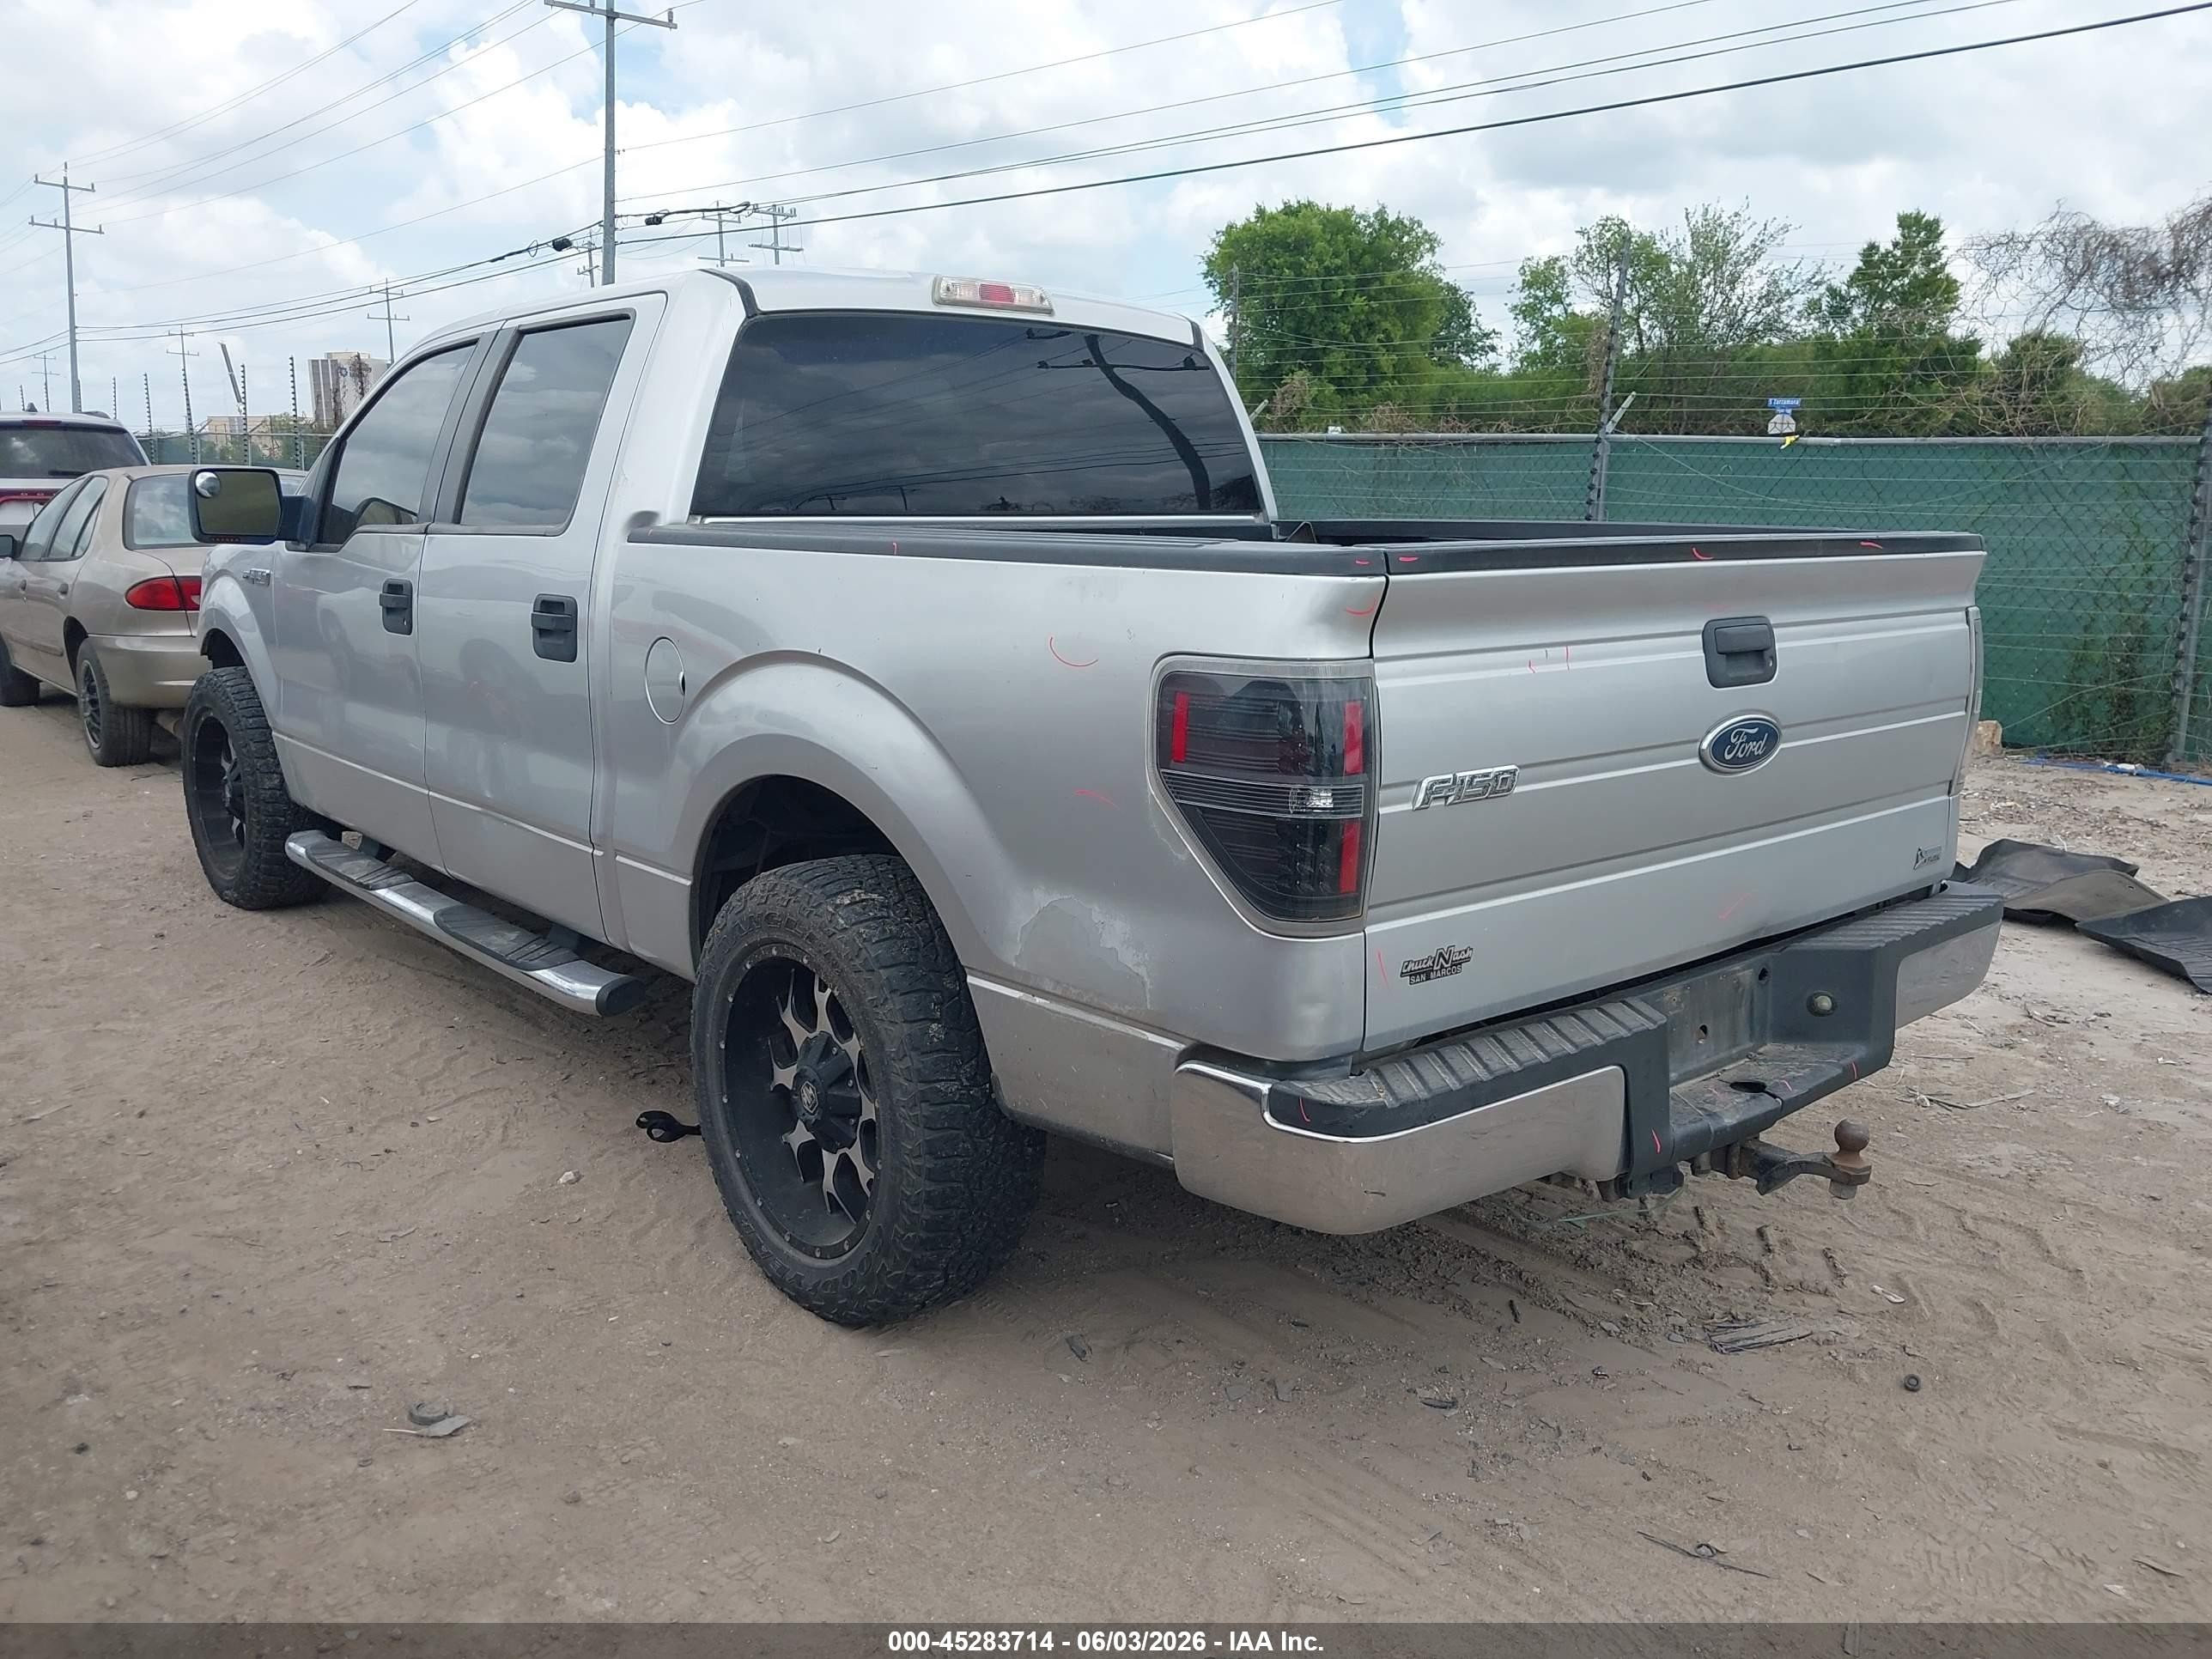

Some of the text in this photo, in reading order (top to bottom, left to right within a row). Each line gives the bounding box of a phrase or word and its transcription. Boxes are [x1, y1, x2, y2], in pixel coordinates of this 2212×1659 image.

[1724, 727, 1767, 760] Ford
[1401, 945, 1474, 974] Chuck Nash
[1409, 964, 1462, 985] SAN MARCOS
